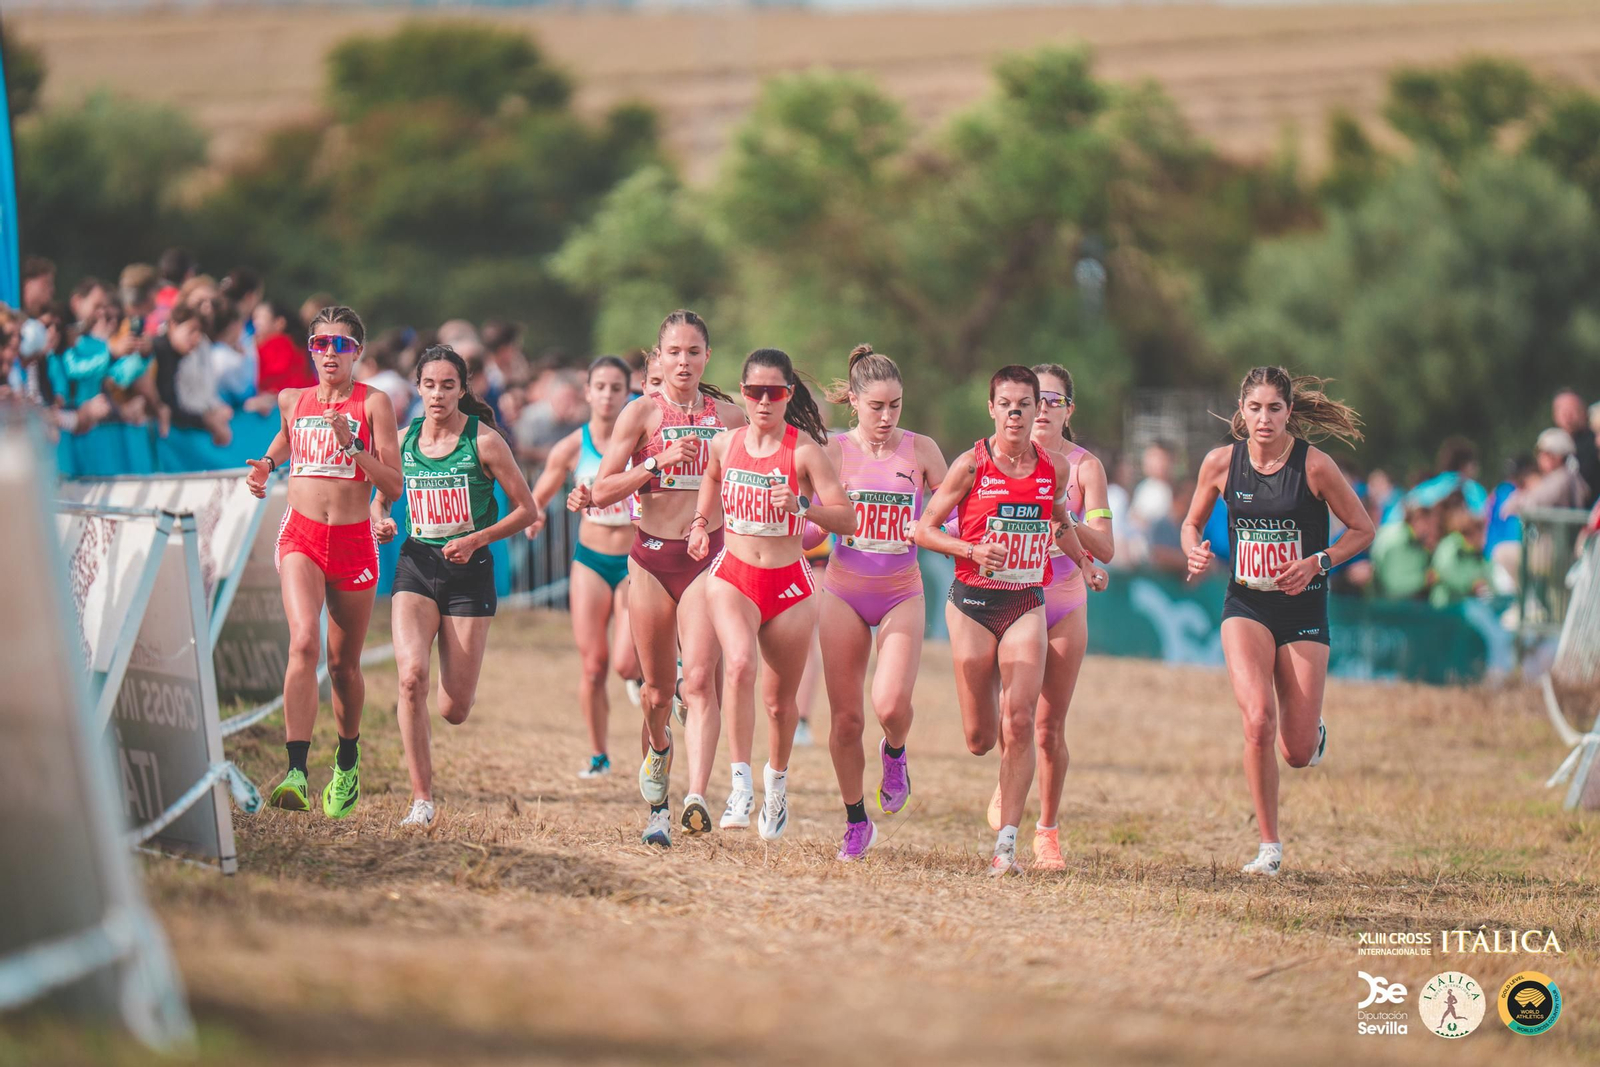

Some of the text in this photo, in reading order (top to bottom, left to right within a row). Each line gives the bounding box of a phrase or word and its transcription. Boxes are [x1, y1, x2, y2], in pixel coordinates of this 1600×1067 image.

[740, 473, 769, 486] ITÁLICA
[864, 491, 897, 503] ITÁLICA
[409, 488, 469, 524] AIT ALIBOU
[1016, 506, 1039, 518] BM
[851, 502, 911, 541] ORERO
[1006, 521, 1037, 531] ITÁLICA
[1237, 517, 1296, 530] OYSHO
[1253, 531, 1282, 541] ITÁLICA
